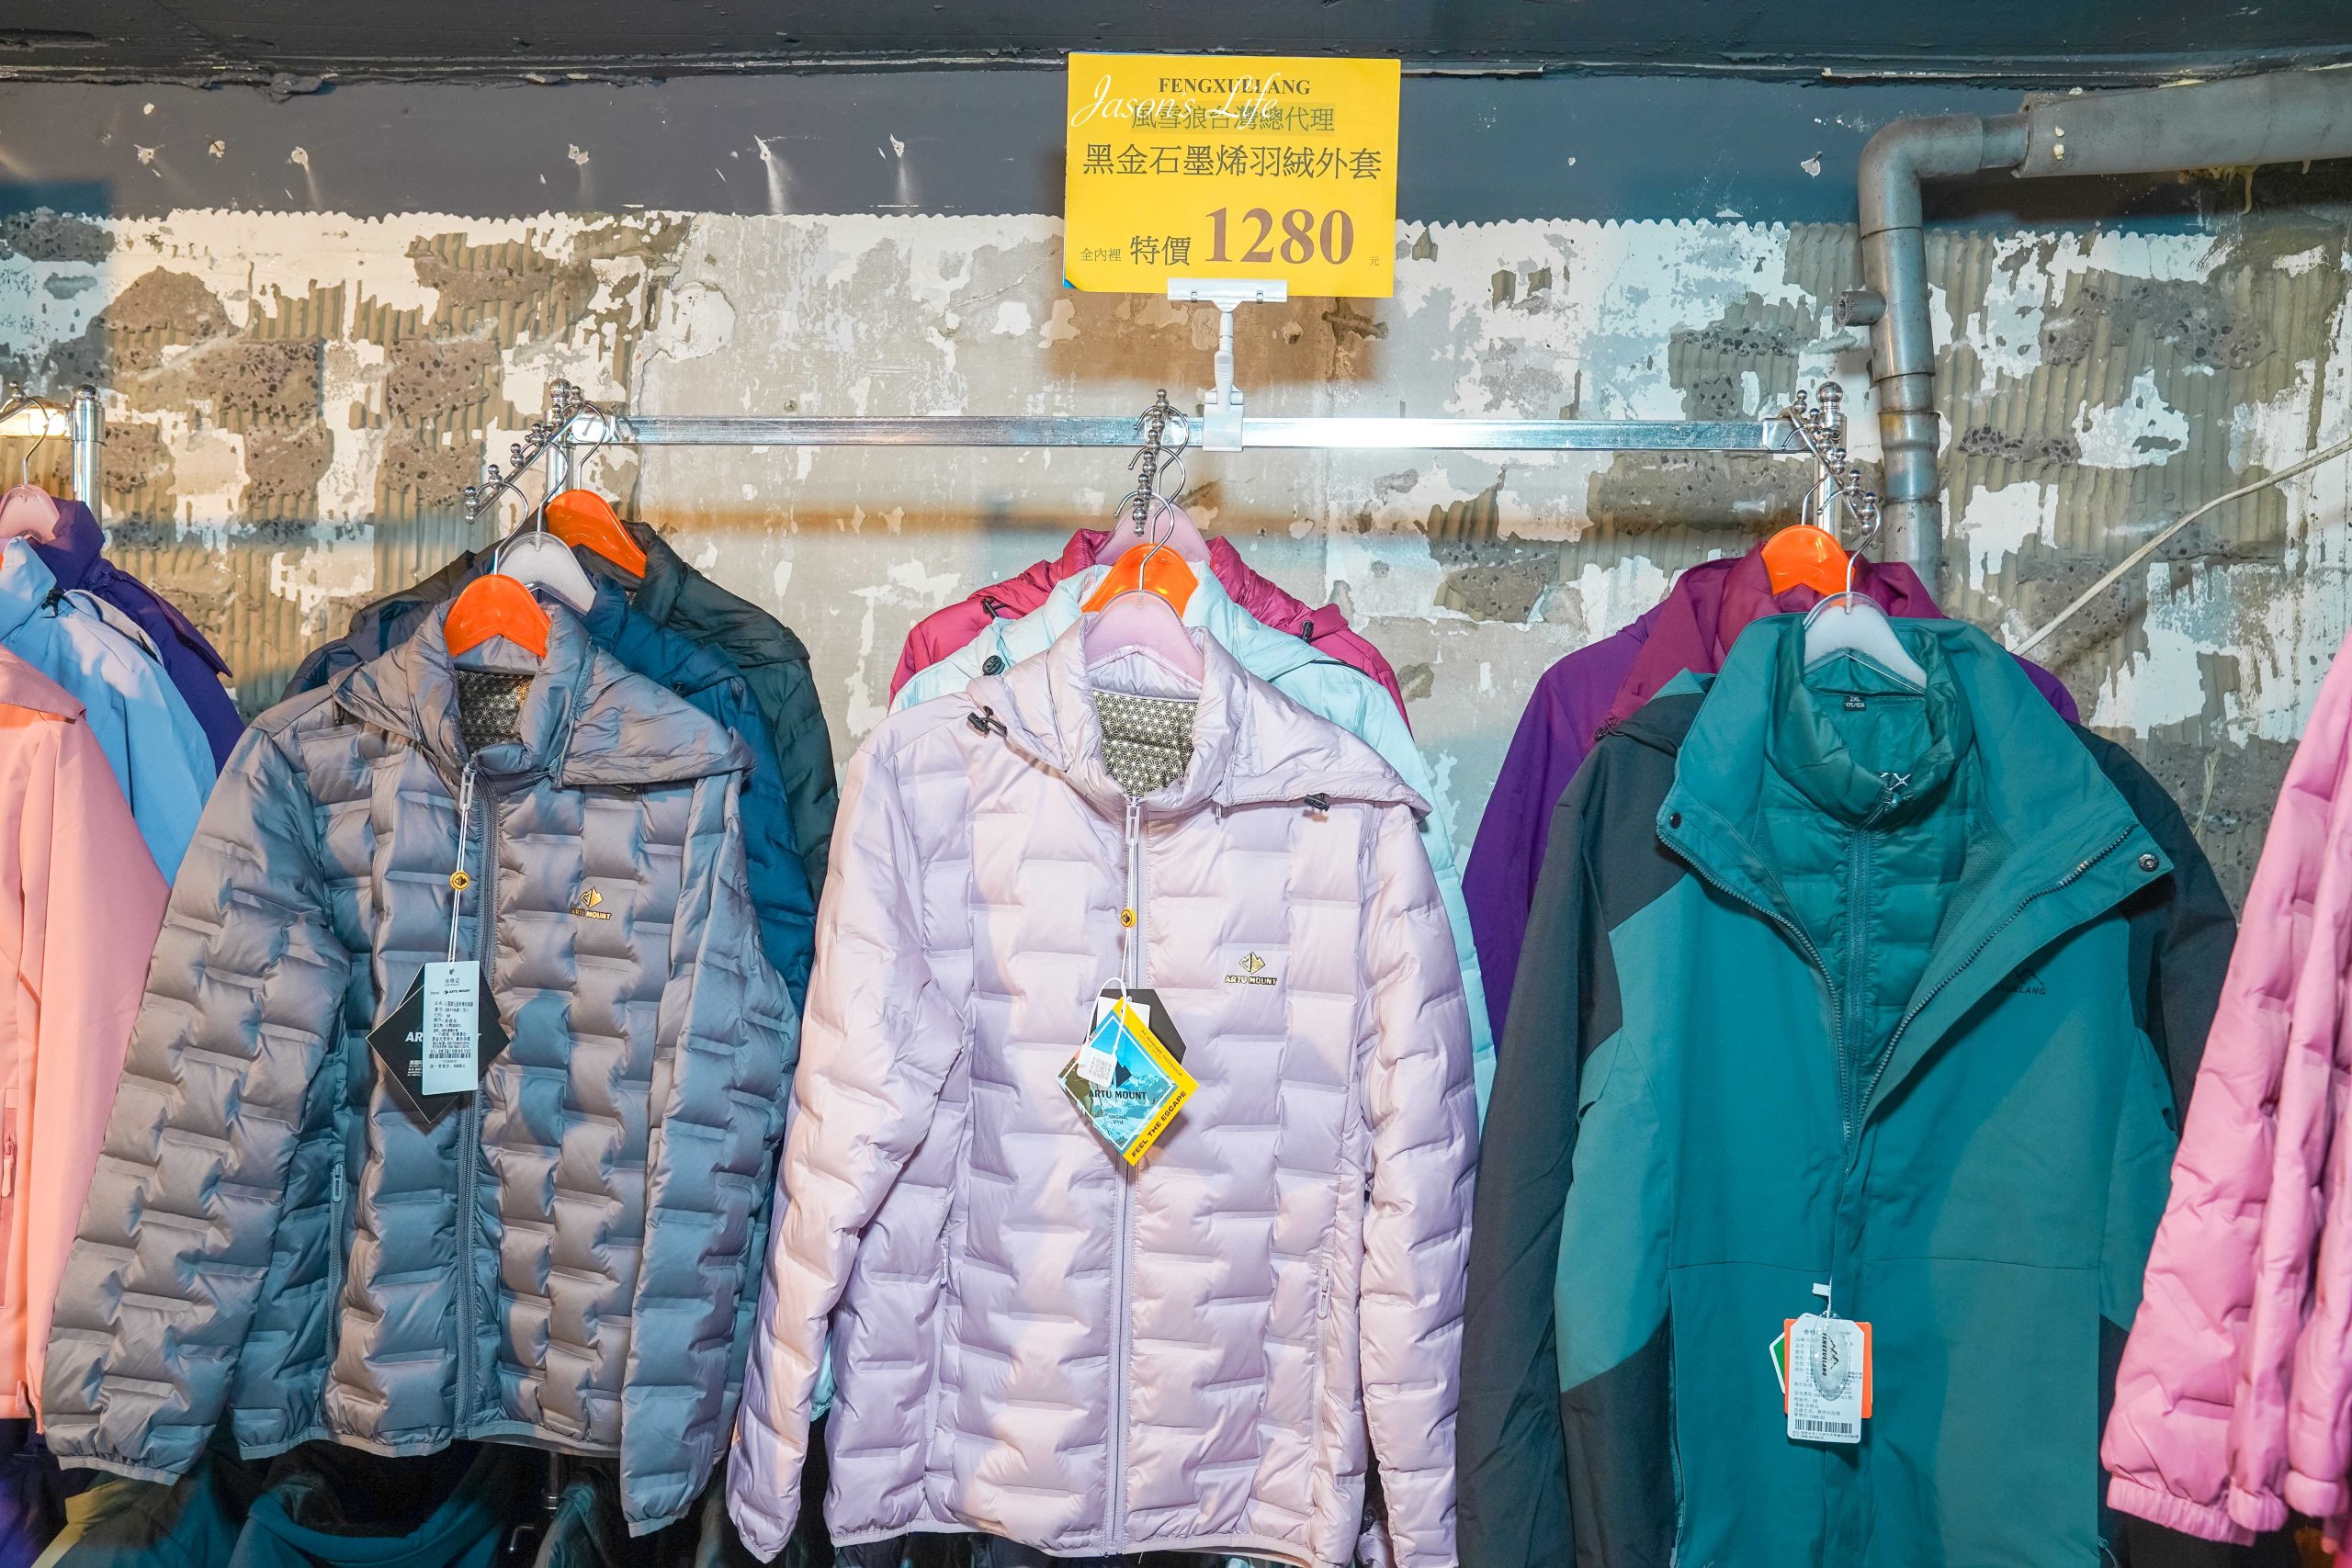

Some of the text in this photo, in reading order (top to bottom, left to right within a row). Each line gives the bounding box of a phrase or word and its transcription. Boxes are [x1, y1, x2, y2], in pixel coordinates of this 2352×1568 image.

[1158, 77, 1311, 96] FENGXUELANG
[1083, 143, 1382, 180] 黑金石墨烯羽絨外套
[1130, 235, 1192, 266] 特價
[1204, 207, 1354, 265] 1280
[1369, 255, 1381, 266] 元
[586, 909, 613, 920] MOUNT
[1225, 975, 1278, 986] ARTU MOUNT
[1088, 1089, 1148, 1100] ARTU MOUNT
[1131, 1089, 1187, 1158] FEEL THE ESCAPE
